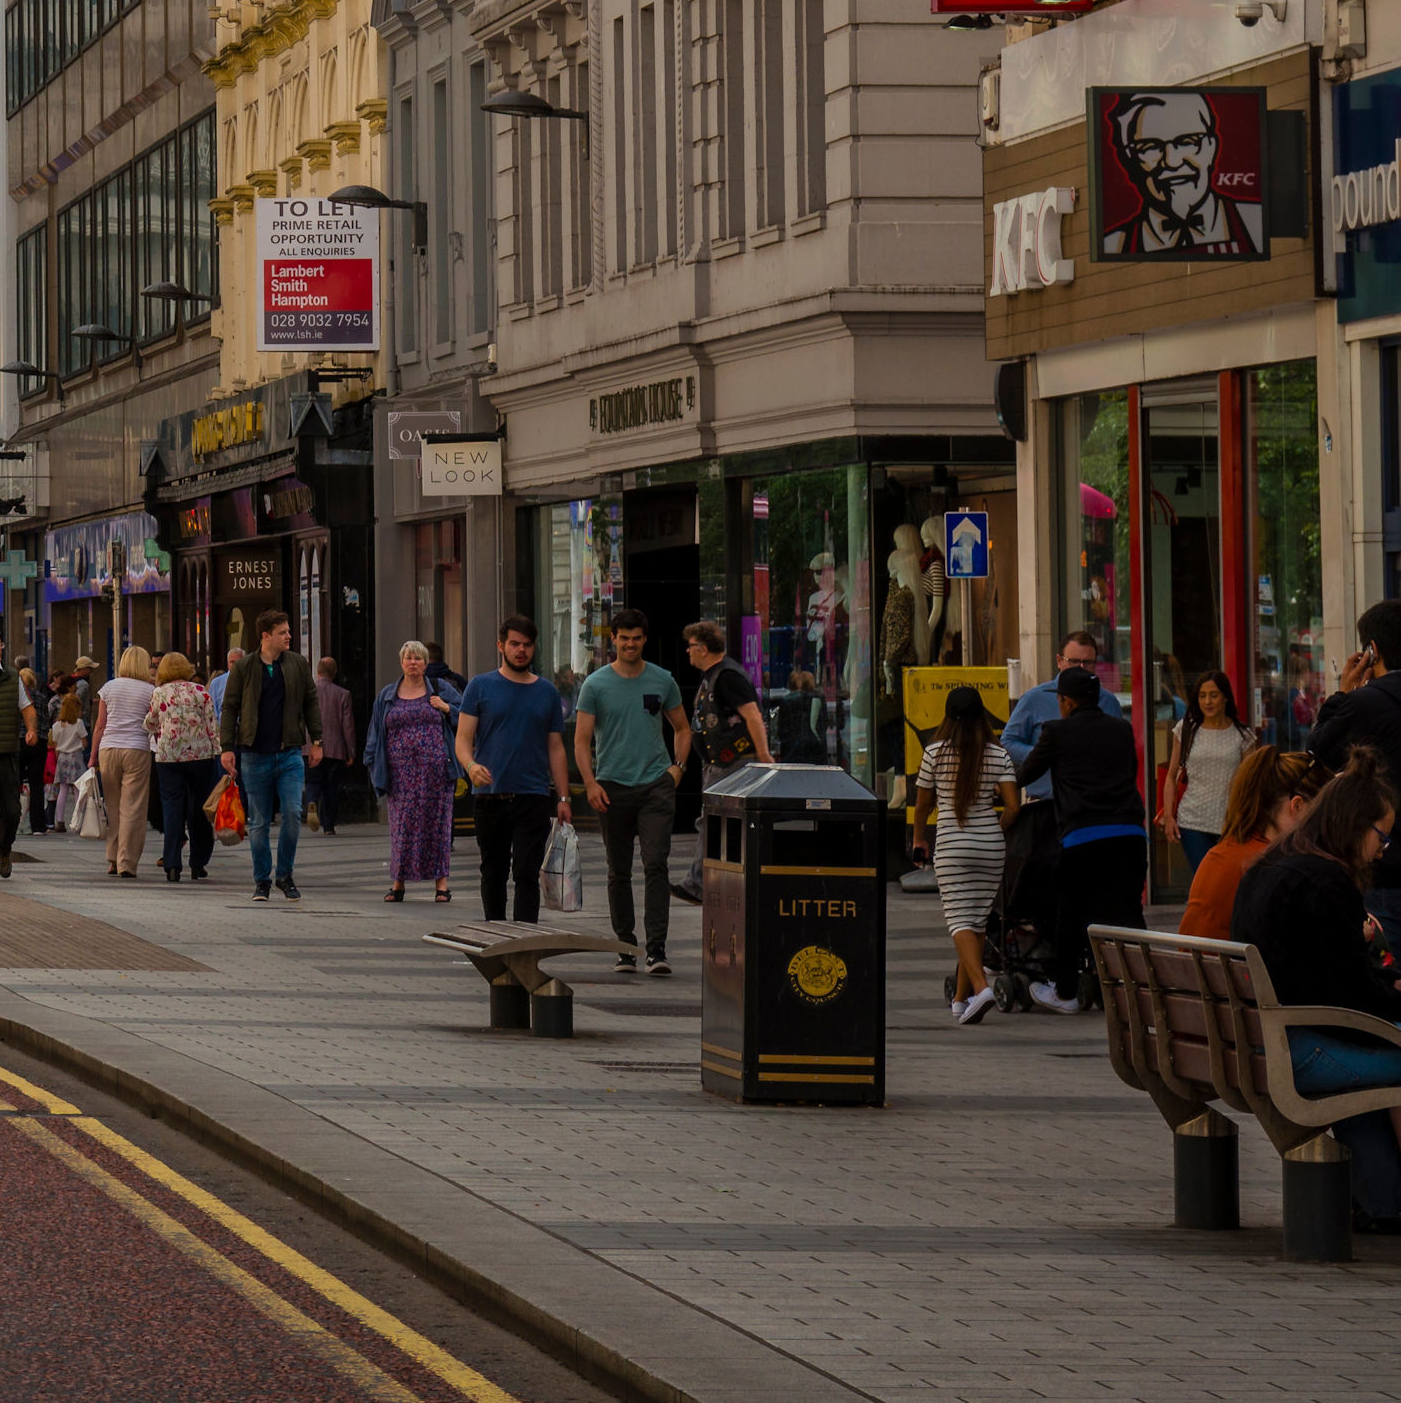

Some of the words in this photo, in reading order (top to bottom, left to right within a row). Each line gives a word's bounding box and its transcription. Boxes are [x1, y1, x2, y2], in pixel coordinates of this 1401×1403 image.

[1217, 172, 1255, 186] KFC
[1332, 138, 1401, 253] pound
[274, 201, 308, 217] TO
[318, 200, 356, 217] LET
[272, 220, 312, 230] PRIME
[317, 219, 362, 230] RETAIL
[270, 233, 364, 245] OPPORTUNITY
[990, 186, 1075, 296] KFC
[279, 248, 297, 256] ALL
[301, 247, 355, 257] ENQUIRIES
[271, 264, 325, 277] Lambert
[271, 279, 308, 292] Smith
[271, 293, 328, 308] Hampton
[271, 314, 296, 327] 028
[299, 314, 332, 327] 9032
[336, 313, 369, 326] 7954
[270, 329, 323, 339] www.lsh.ie
[435, 451, 488, 465] NEW
[430, 469, 494, 483] LOOK
[228, 560, 275, 574] ERNEST
[233, 576, 272, 590] JONES
[931, 682, 943, 690] The
[779, 899, 856, 918] LITTER
